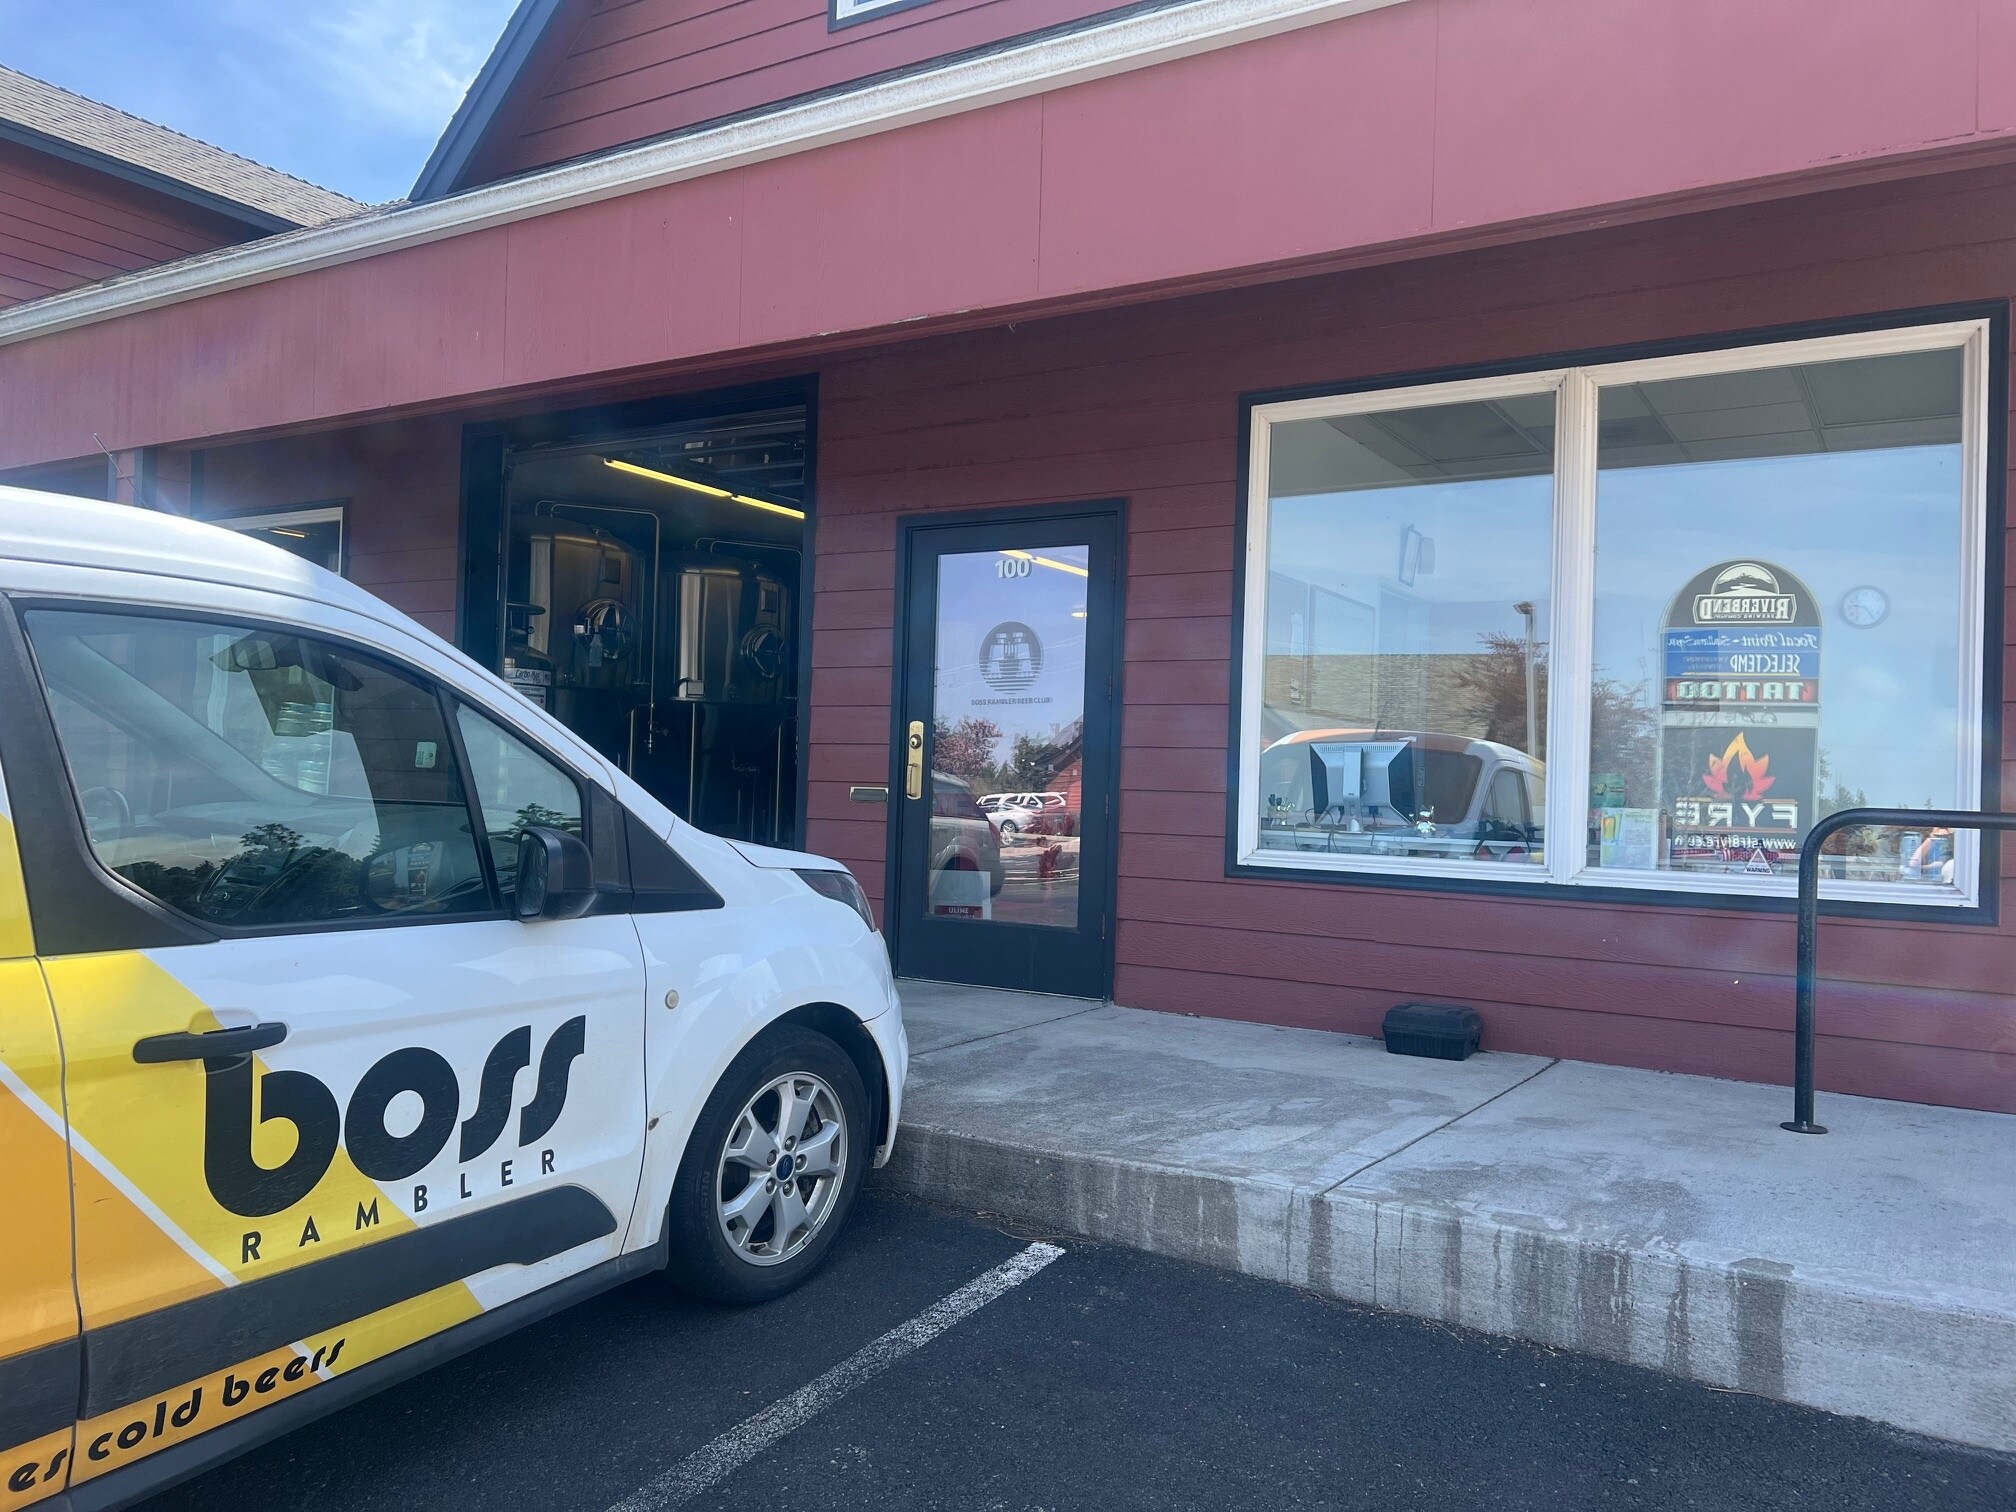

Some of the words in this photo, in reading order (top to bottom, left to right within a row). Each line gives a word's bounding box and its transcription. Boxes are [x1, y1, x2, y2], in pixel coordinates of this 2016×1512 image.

[995, 558, 1032, 578] 100
[203, 1014, 586, 1217] boss
[241, 1148, 555, 1263] RAMBLER
[88, 1388, 202, 1461] cold
[221, 1337, 347, 1406] beers
